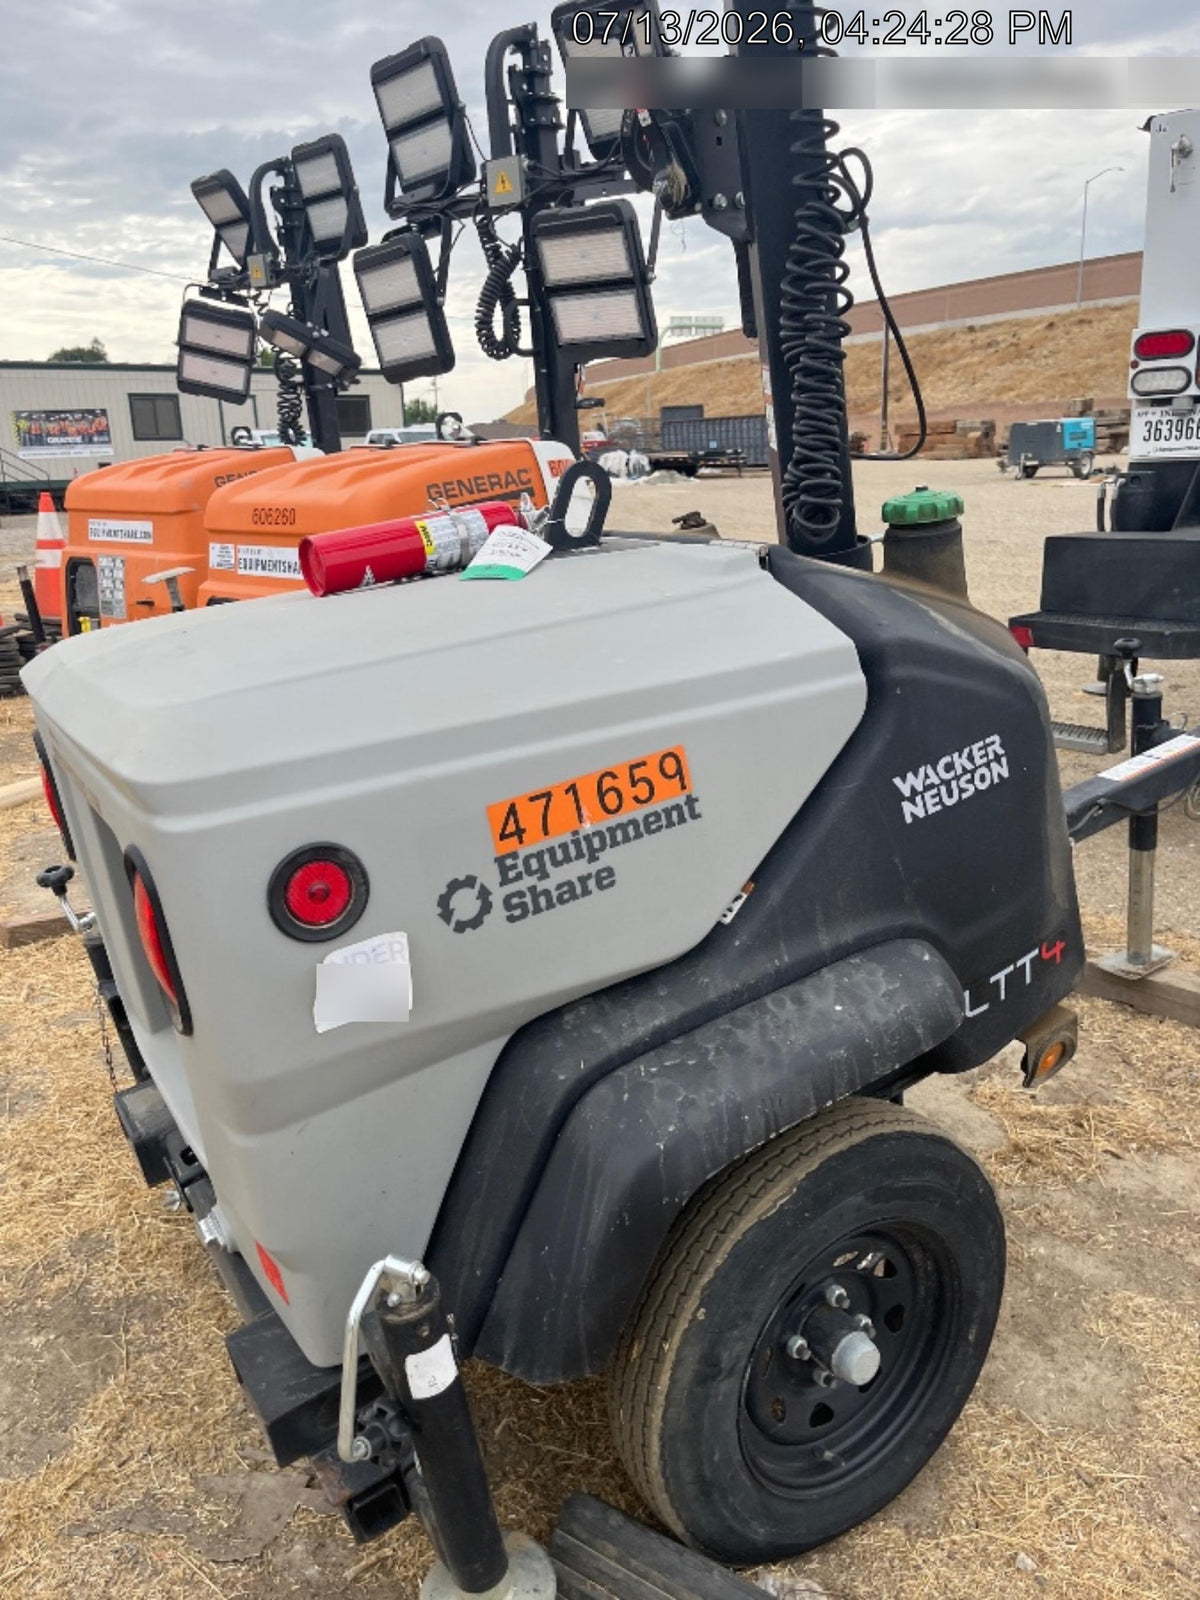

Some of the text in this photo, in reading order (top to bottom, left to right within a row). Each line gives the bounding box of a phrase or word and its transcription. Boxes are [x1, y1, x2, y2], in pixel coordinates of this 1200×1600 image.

[426, 468, 532, 501] GENERAC
[499, 751, 687, 845] 471659
[892, 733, 1005, 798] WACKER
[901, 755, 1009, 824] NEUSON
[494, 793, 702, 887] Equipment
[502, 865, 616, 924] Share
[963, 940, 1066, 1018] LTT4
